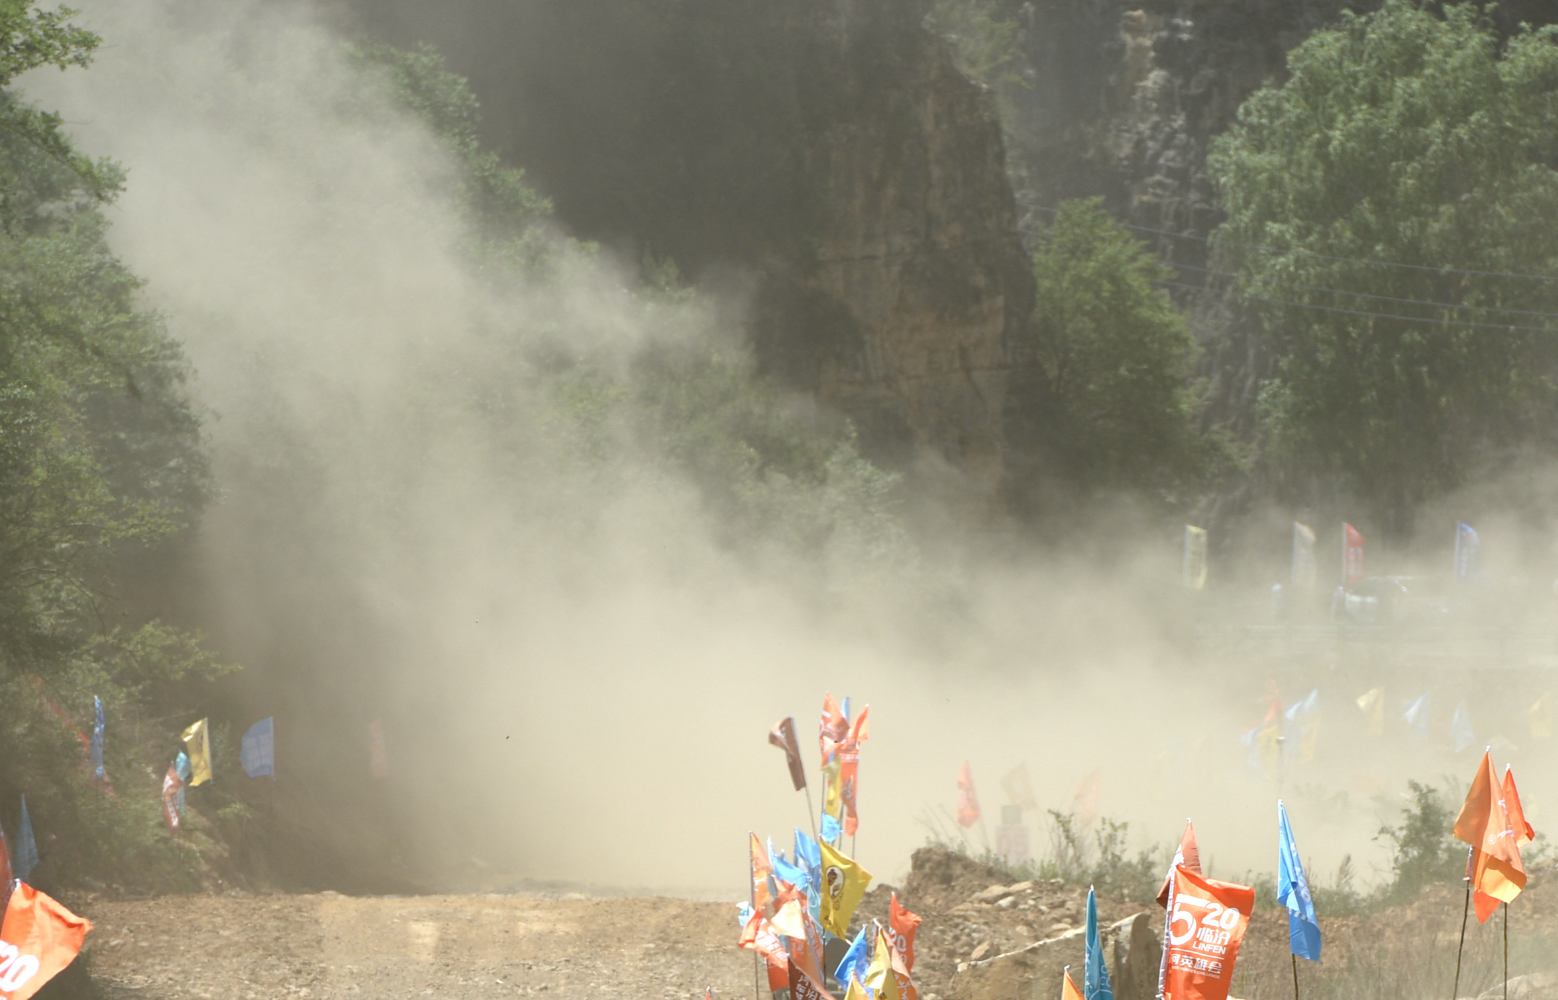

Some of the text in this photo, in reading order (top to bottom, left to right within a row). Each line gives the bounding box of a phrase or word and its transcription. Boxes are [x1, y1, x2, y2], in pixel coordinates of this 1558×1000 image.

[1170, 894, 1240, 945] 520
[1196, 927, 1231, 946] 临汾
[1192, 941, 1227, 955] LINFEN
